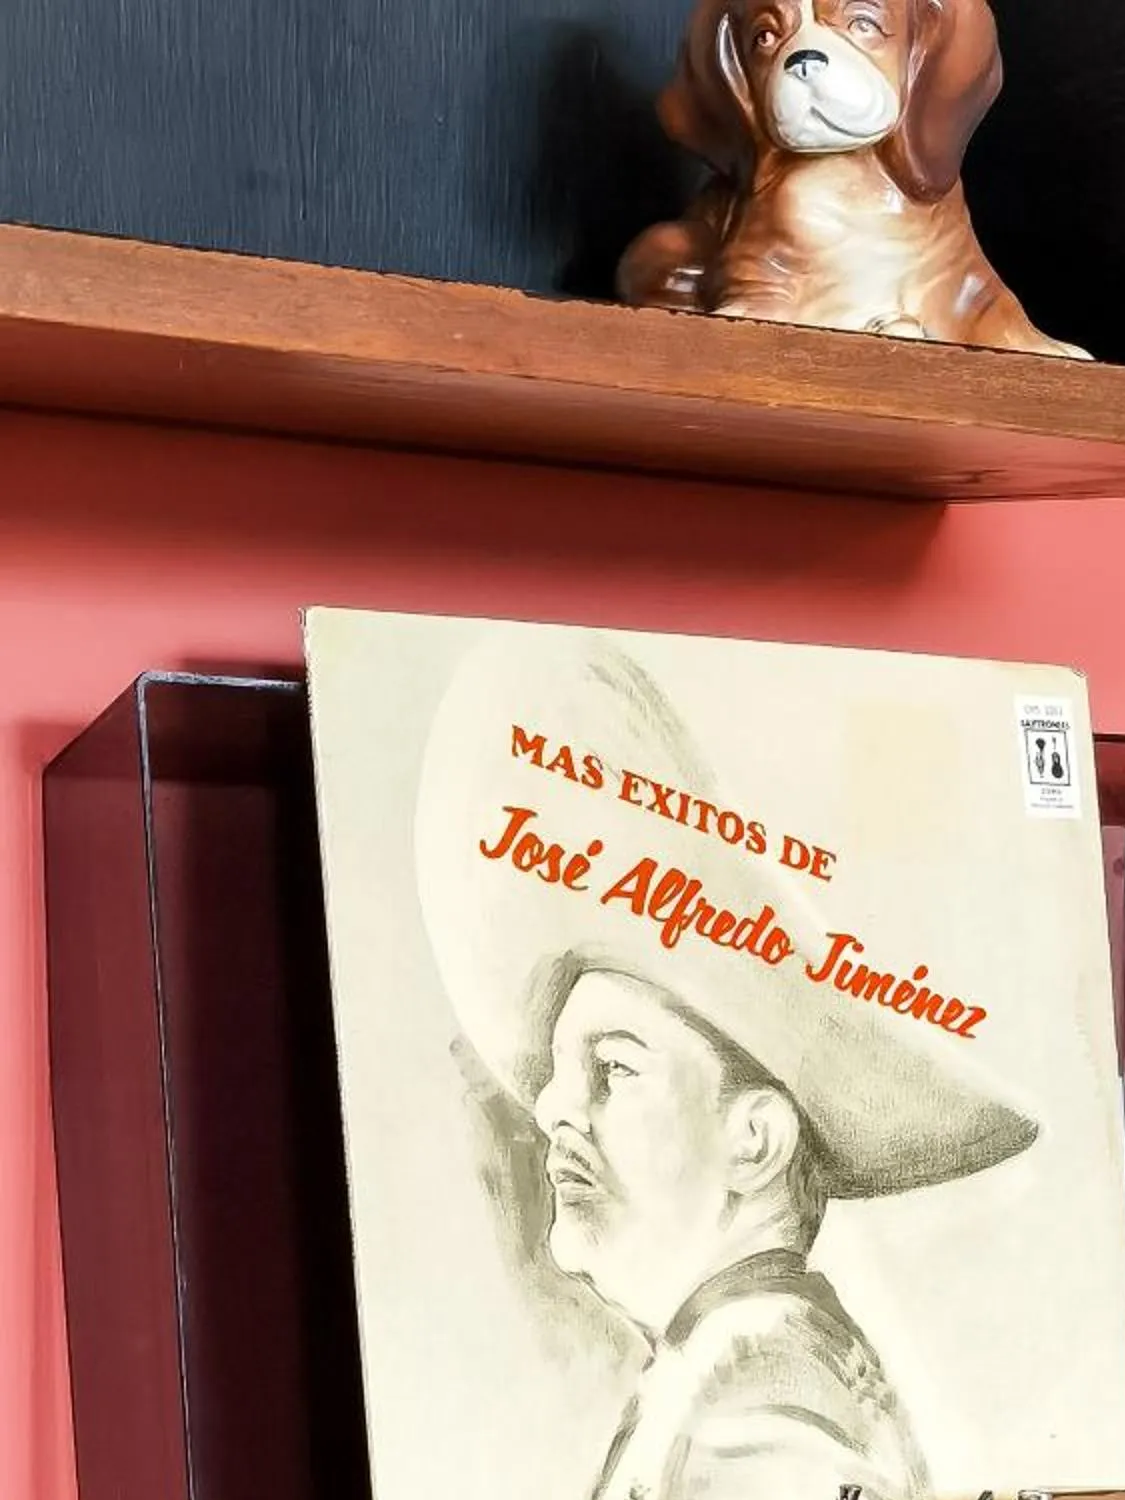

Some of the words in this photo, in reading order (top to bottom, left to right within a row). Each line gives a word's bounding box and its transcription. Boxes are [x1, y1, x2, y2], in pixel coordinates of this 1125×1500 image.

[510, 724, 604, 790] MAS
[616, 769, 768, 855] EXITOS
[778, 834, 838, 882] DE
[478, 805, 604, 891] José
[600, 857, 794, 966] Alfredo
[804, 931, 988, 1040] Jiménez
